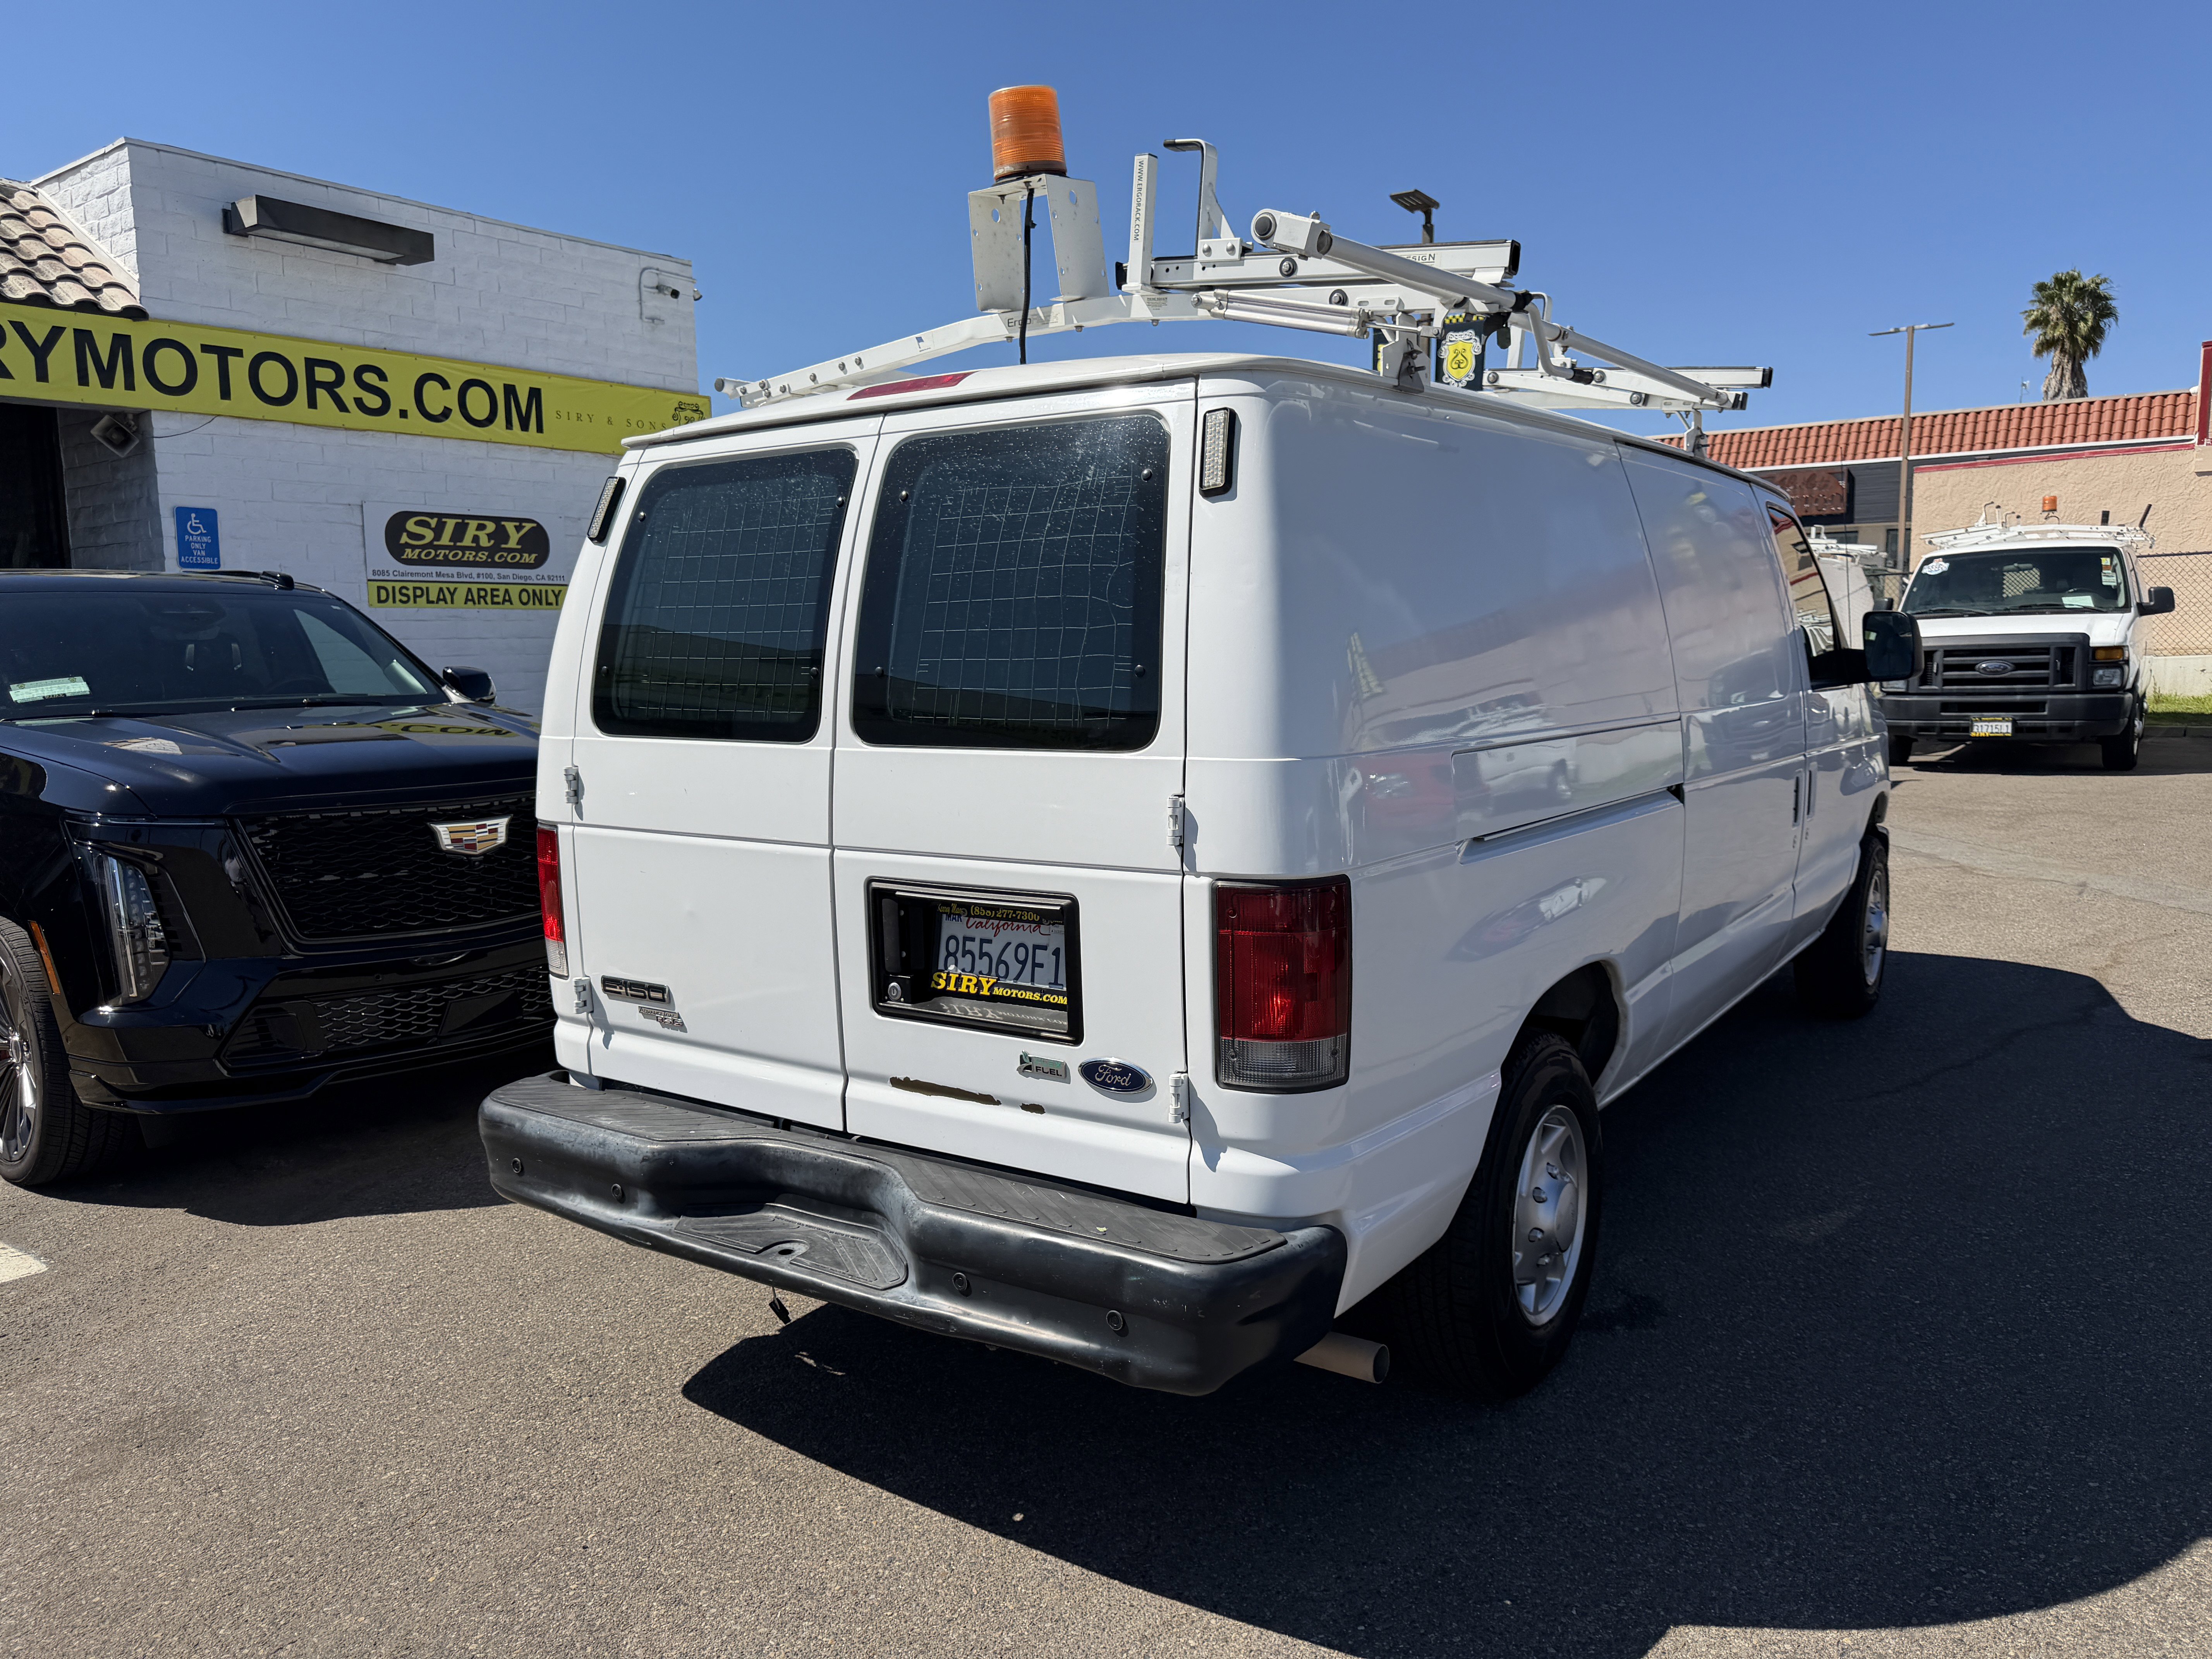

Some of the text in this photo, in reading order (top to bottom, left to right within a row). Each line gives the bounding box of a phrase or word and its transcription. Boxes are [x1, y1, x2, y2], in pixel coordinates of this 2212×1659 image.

[1134, 160, 1144, 241] WWW.ERGORACK.COM
[556, 410, 594, 423] SIRY
[607, 417, 613, 425] &
[185, 535, 211, 543] PARKING
[399, 516, 537, 548] SIRY
[401, 549, 538, 563] MOTORS.COM
[376, 585, 562, 606] DISPLAY AREA ONLY
[996, 909, 1040, 921] 277-7300
[966, 917, 1051, 937] California
[944, 934, 1064, 989] 85569F1
[930, 972, 1068, 1005] SIRY MOTORS.COM
[1035, 1066, 1062, 1077] FUEL
[1095, 1065, 1132, 1086] Ford
